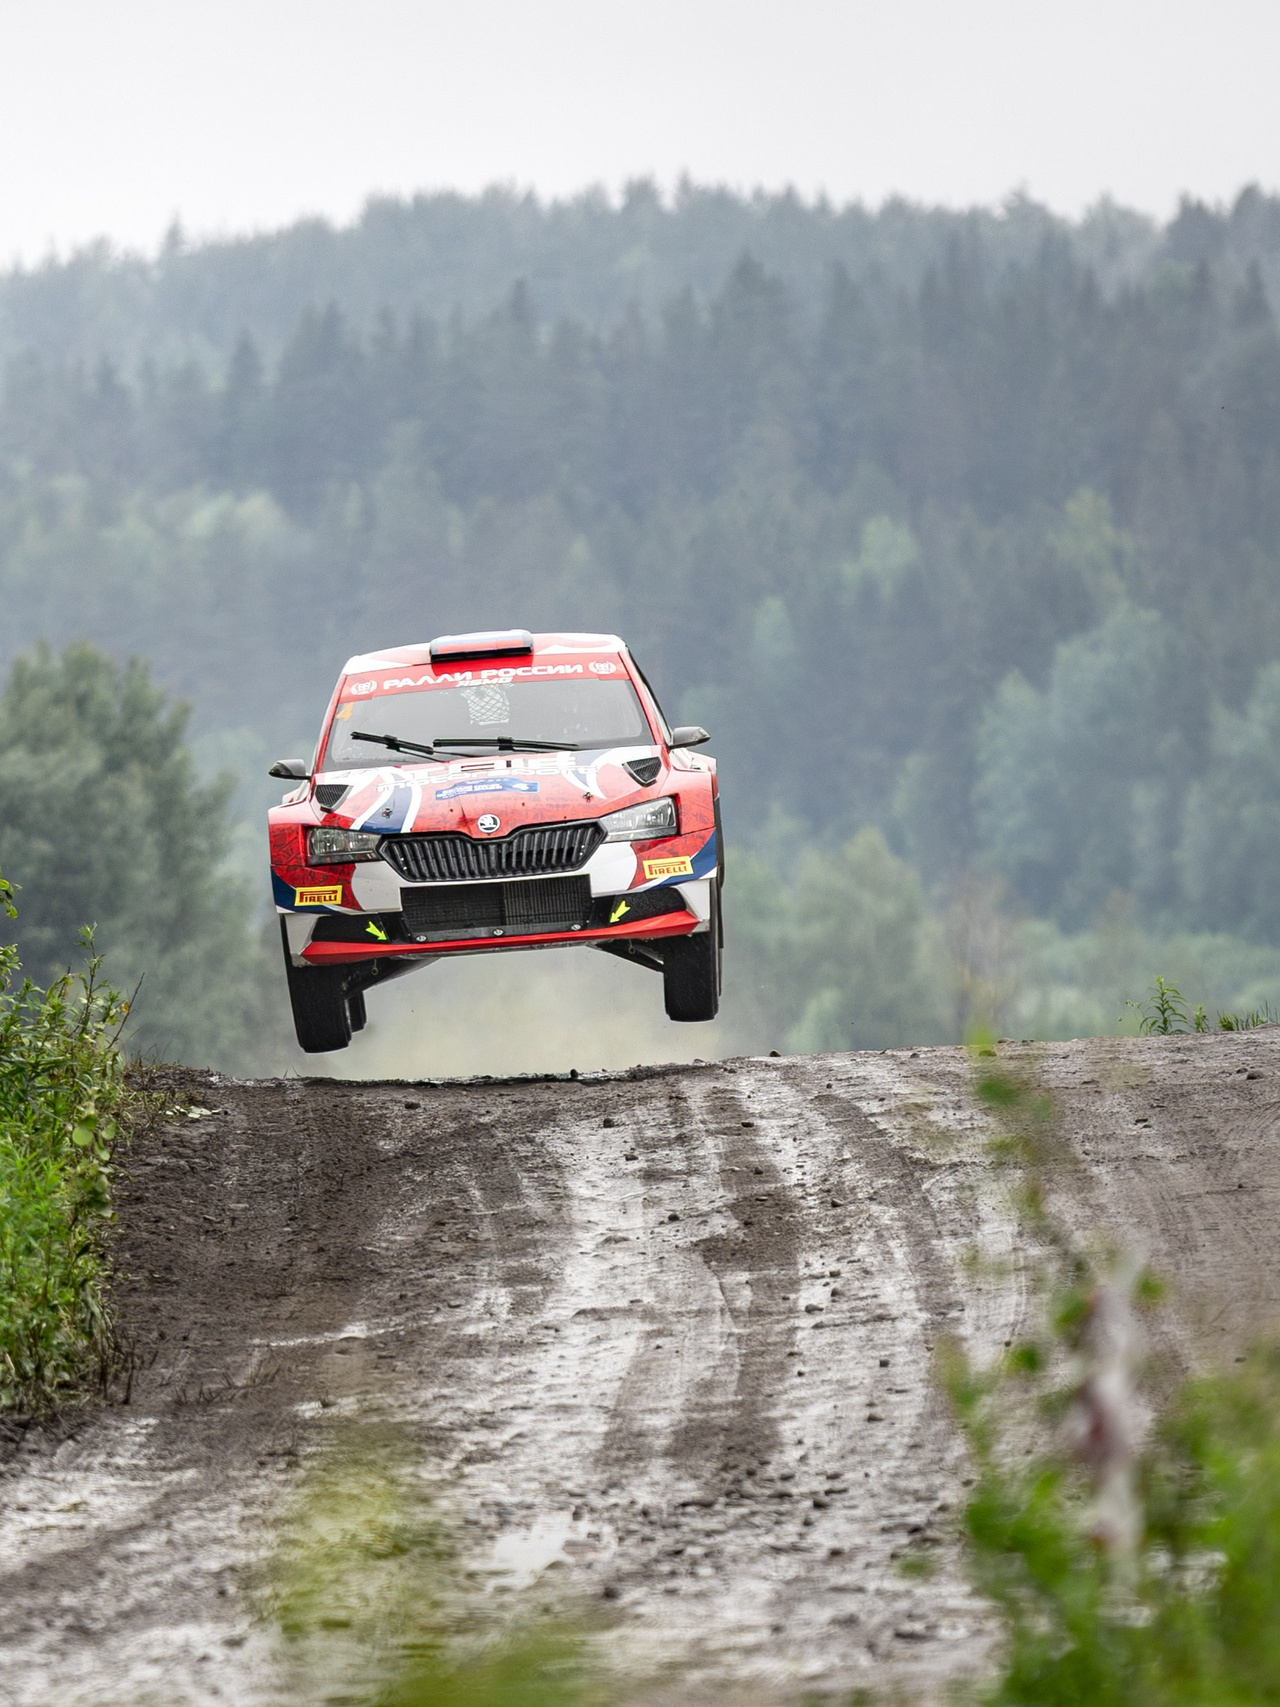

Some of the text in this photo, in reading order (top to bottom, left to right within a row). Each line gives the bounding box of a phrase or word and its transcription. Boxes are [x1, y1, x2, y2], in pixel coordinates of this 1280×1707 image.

[383, 671, 472, 690] РАЛЛИ
[481, 664, 583, 679] РОССИИ
[648, 860, 688, 876] PIRELLI
[299, 889, 339, 903] PIRELLI
